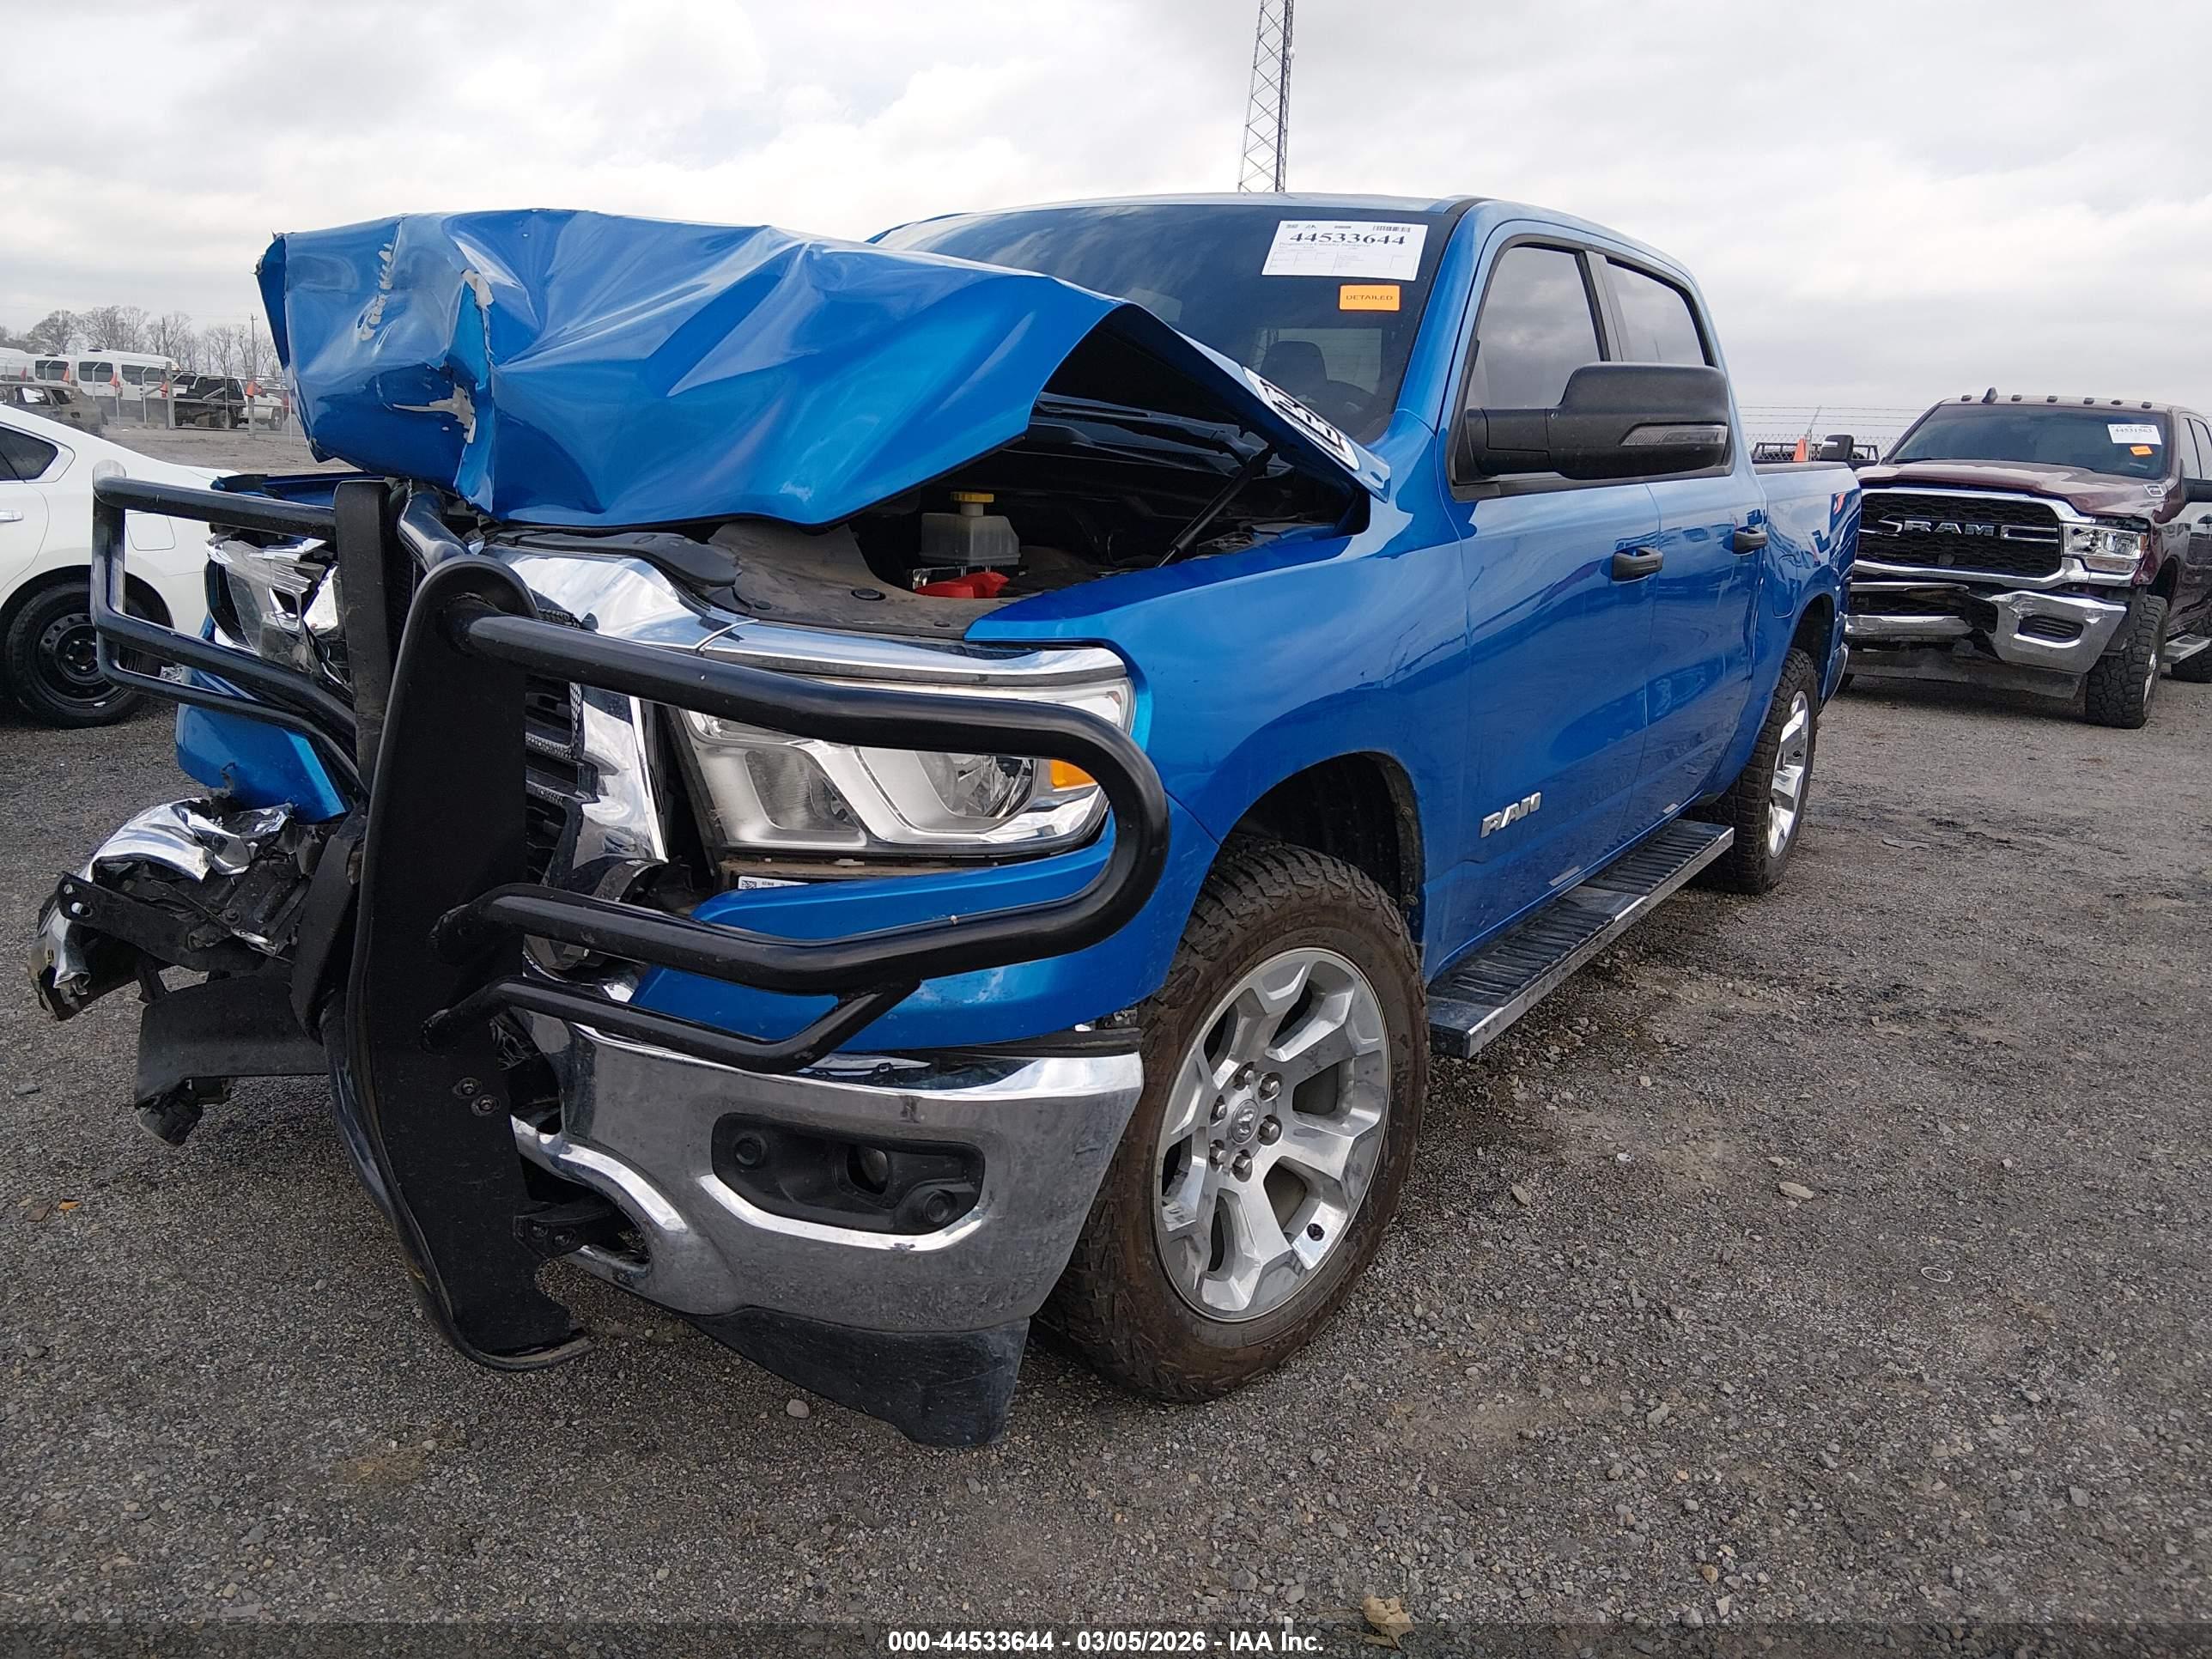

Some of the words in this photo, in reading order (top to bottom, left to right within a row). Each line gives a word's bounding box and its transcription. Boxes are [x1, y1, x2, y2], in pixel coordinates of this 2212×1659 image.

[1290, 232, 1406, 246] 44533644
[1905, 520, 1995, 537] RAM
[1480, 791, 1541, 839] RAM
